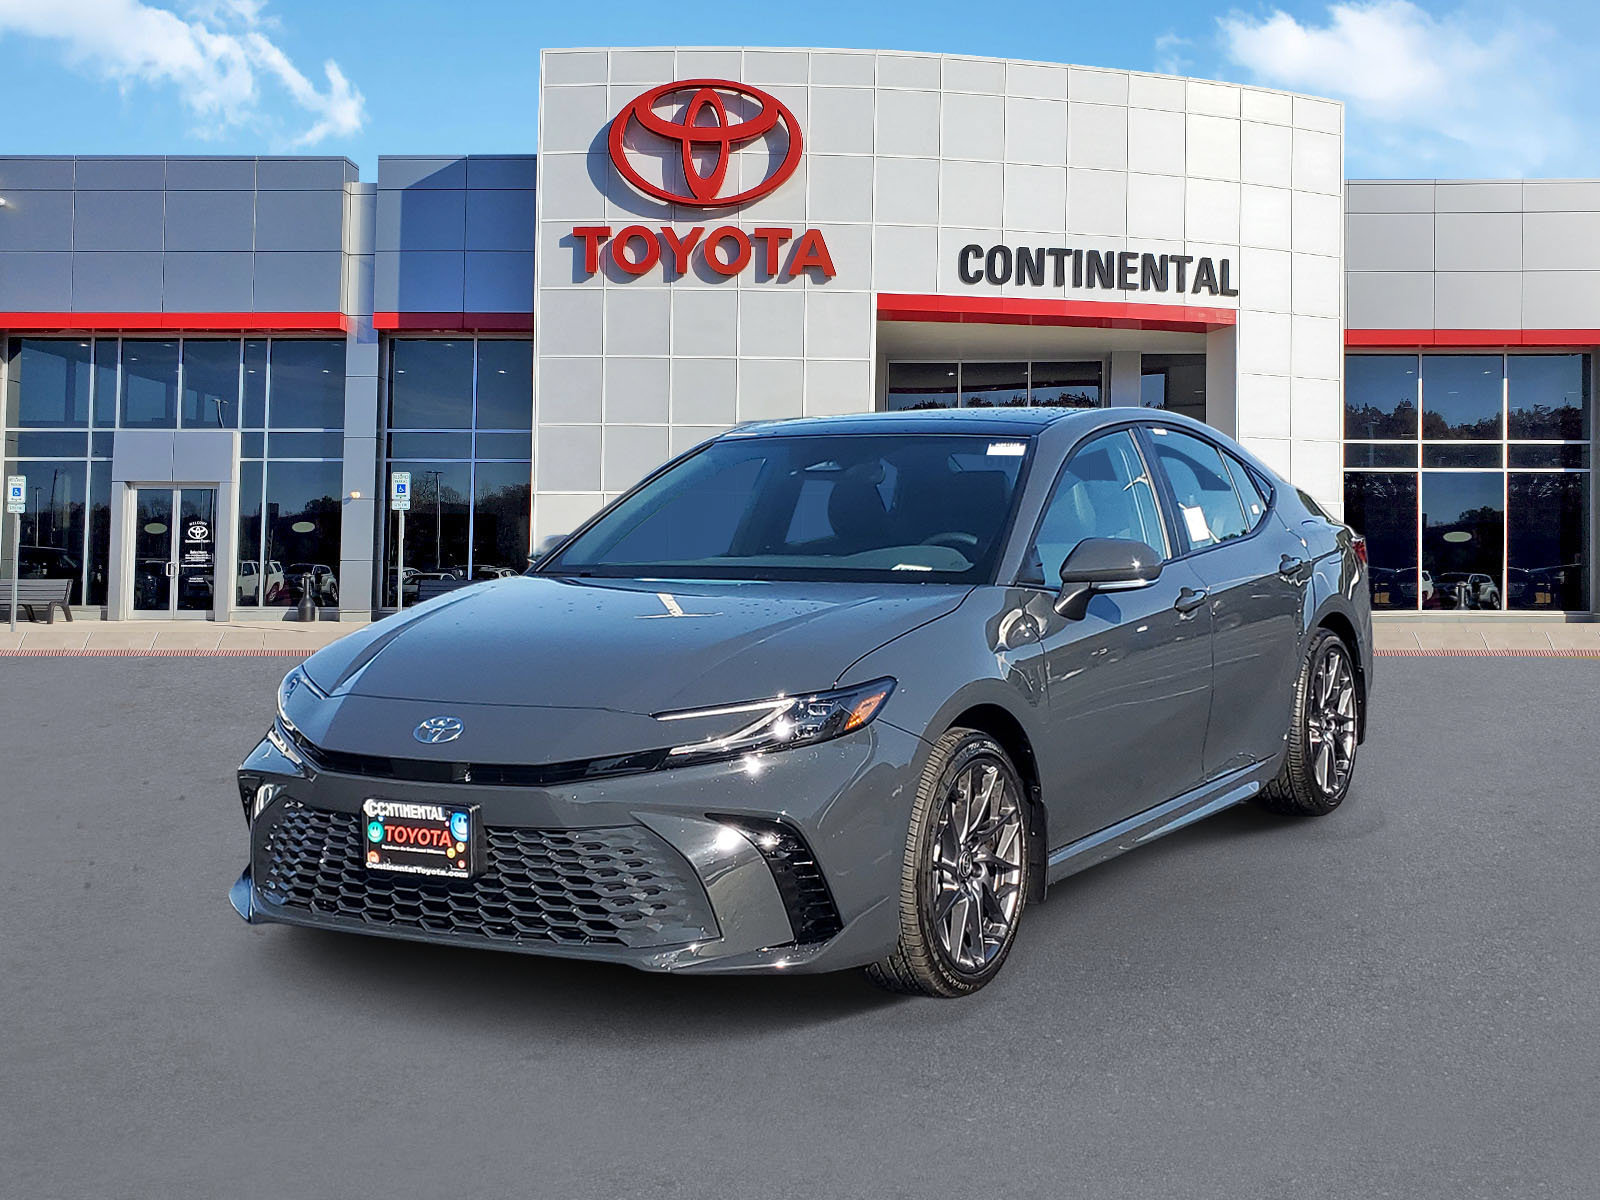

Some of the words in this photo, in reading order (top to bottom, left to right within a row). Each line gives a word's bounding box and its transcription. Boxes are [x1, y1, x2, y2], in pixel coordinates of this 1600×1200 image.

[572, 225, 837, 276] TOYOTA
[958, 244, 1239, 297] CONTINENTAL
[384, 825, 452, 847] TOYOTA
[365, 861, 468, 878] ContinentalToyota.com
[938, 963, 974, 991] TURANZA
